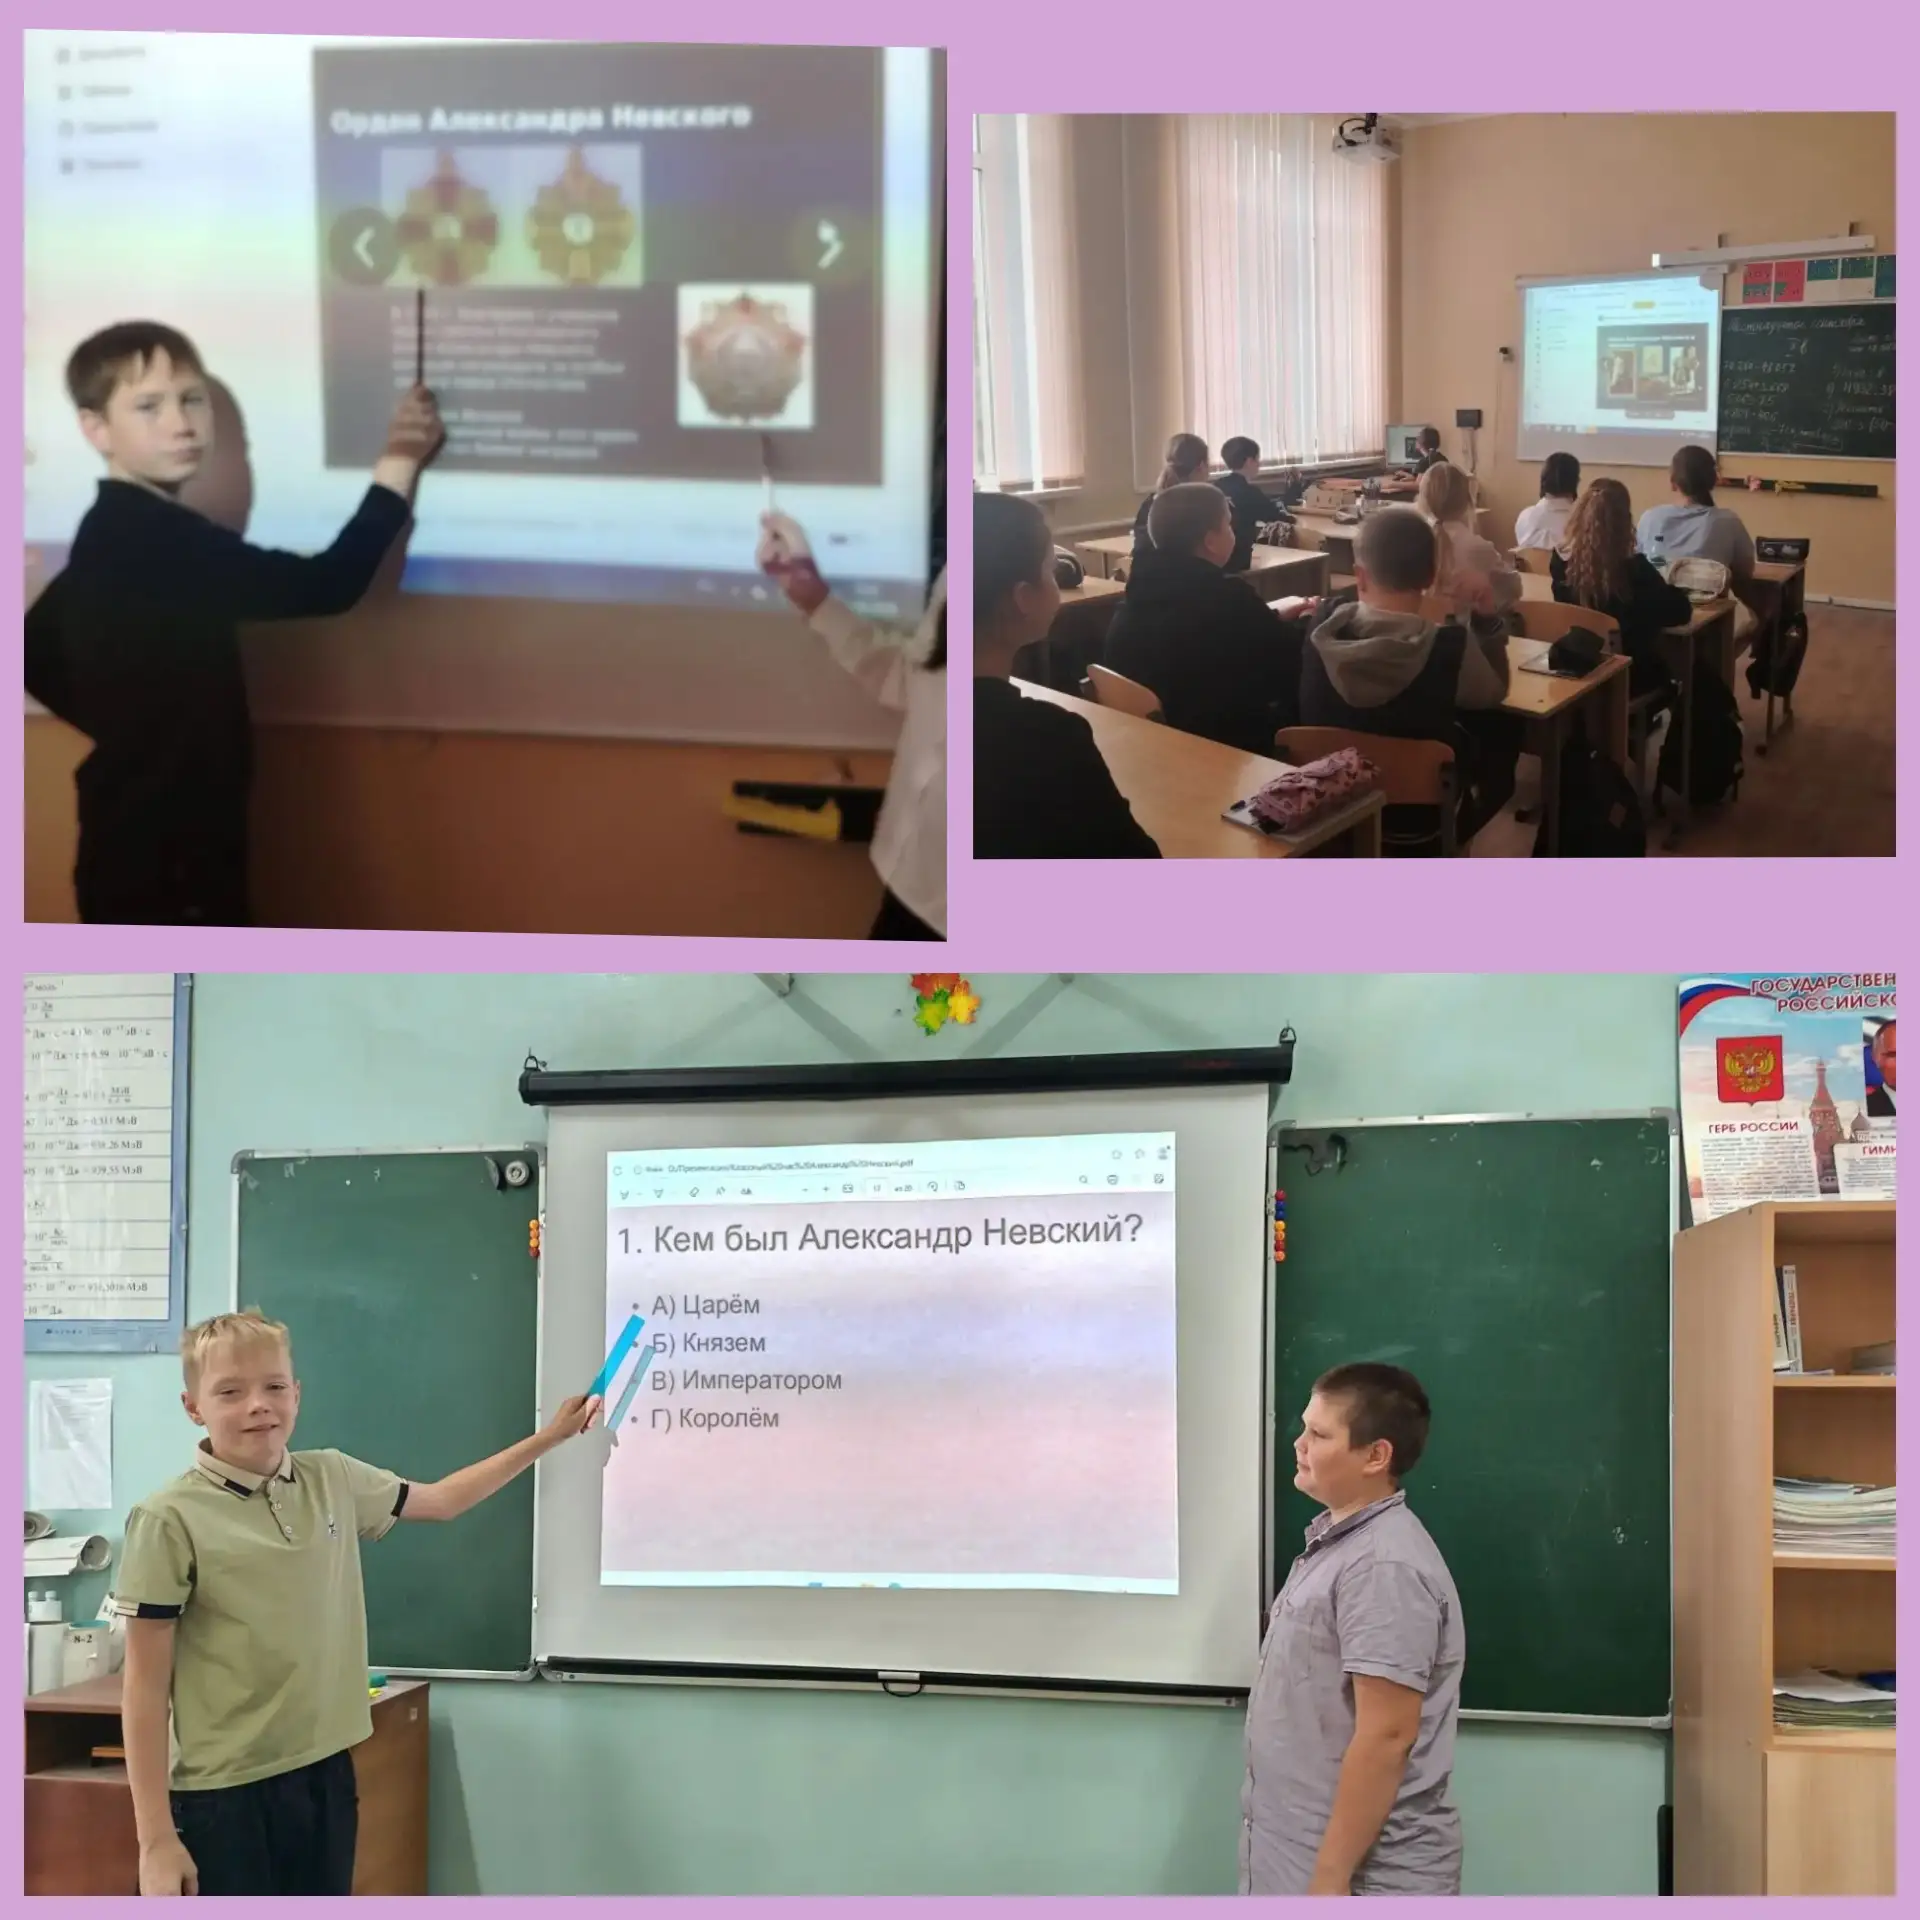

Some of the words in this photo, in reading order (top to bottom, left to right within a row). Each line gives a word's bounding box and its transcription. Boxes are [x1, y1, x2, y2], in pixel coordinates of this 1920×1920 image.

[331, 109, 422, 137] Орден
[428, 107, 603, 134] Александра
[612, 103, 752, 128] Невского
[1751, 973, 1896, 993] ГОСУДАРСТВЕН
[1708, 1124, 1737, 1133] ГЕРБ
[1740, 1121, 1799, 1133] РОССИИ
[619, 1227, 642, 1255] 1.
[654, 1225, 714, 1254] Кем
[724, 1223, 788, 1252] был
[798, 1222, 973, 1254] Александр
[983, 1213, 1144, 1247] Невский?
[651, 1294, 676, 1321] А)
[683, 1292, 761, 1320] Царём
[653, 1332, 676, 1359] Б)
[683, 1332, 767, 1354] Князем
[651, 1369, 676, 1396] В)
[682, 1369, 843, 1396] Императором
[651, 1407, 672, 1435] Г)
[679, 1406, 780, 1433] Королём
